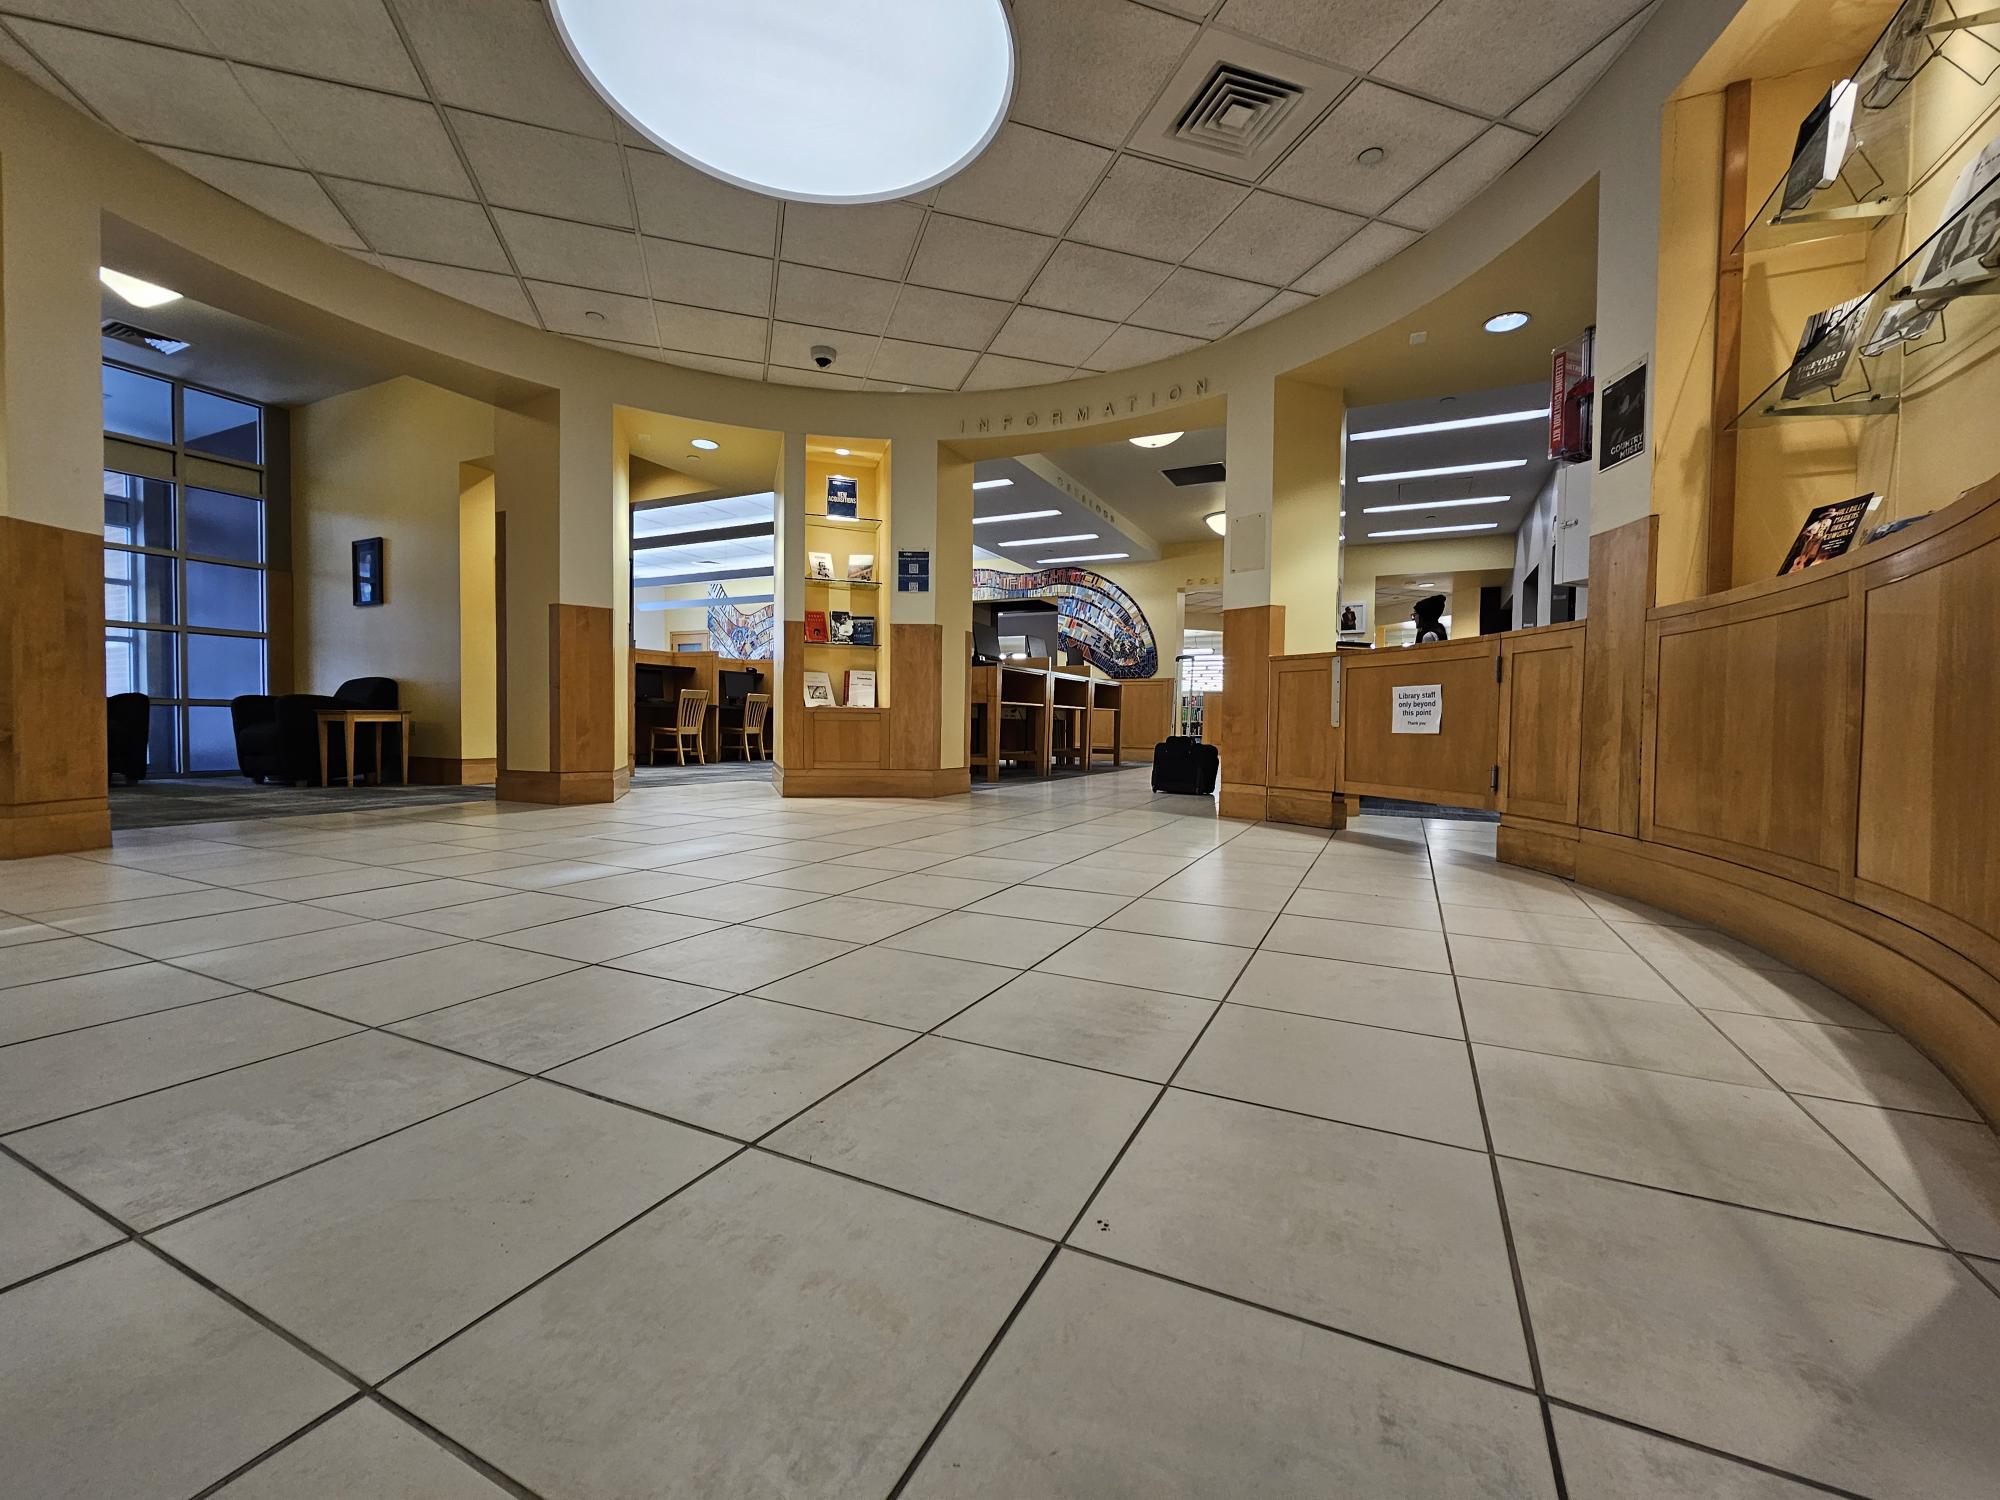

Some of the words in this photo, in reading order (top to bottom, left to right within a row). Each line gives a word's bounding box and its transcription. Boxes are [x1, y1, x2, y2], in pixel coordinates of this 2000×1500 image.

[1555, 356, 1564, 393] BLEEDING
[960, 377, 1209, 433] INFORMATION
[1553, 393, 1562, 429] CONTROL
[1552, 429, 1561, 441] KIT
[1610, 433, 1643, 455] COUNTRY
[1619, 441, 1643, 459] MUSIC
[828, 495, 857, 504] ACQUISITIONS
[1398, 692, 1420, 700] Library
[1398, 701, 1412, 709] only
[1413, 700, 1436, 708] beyond
